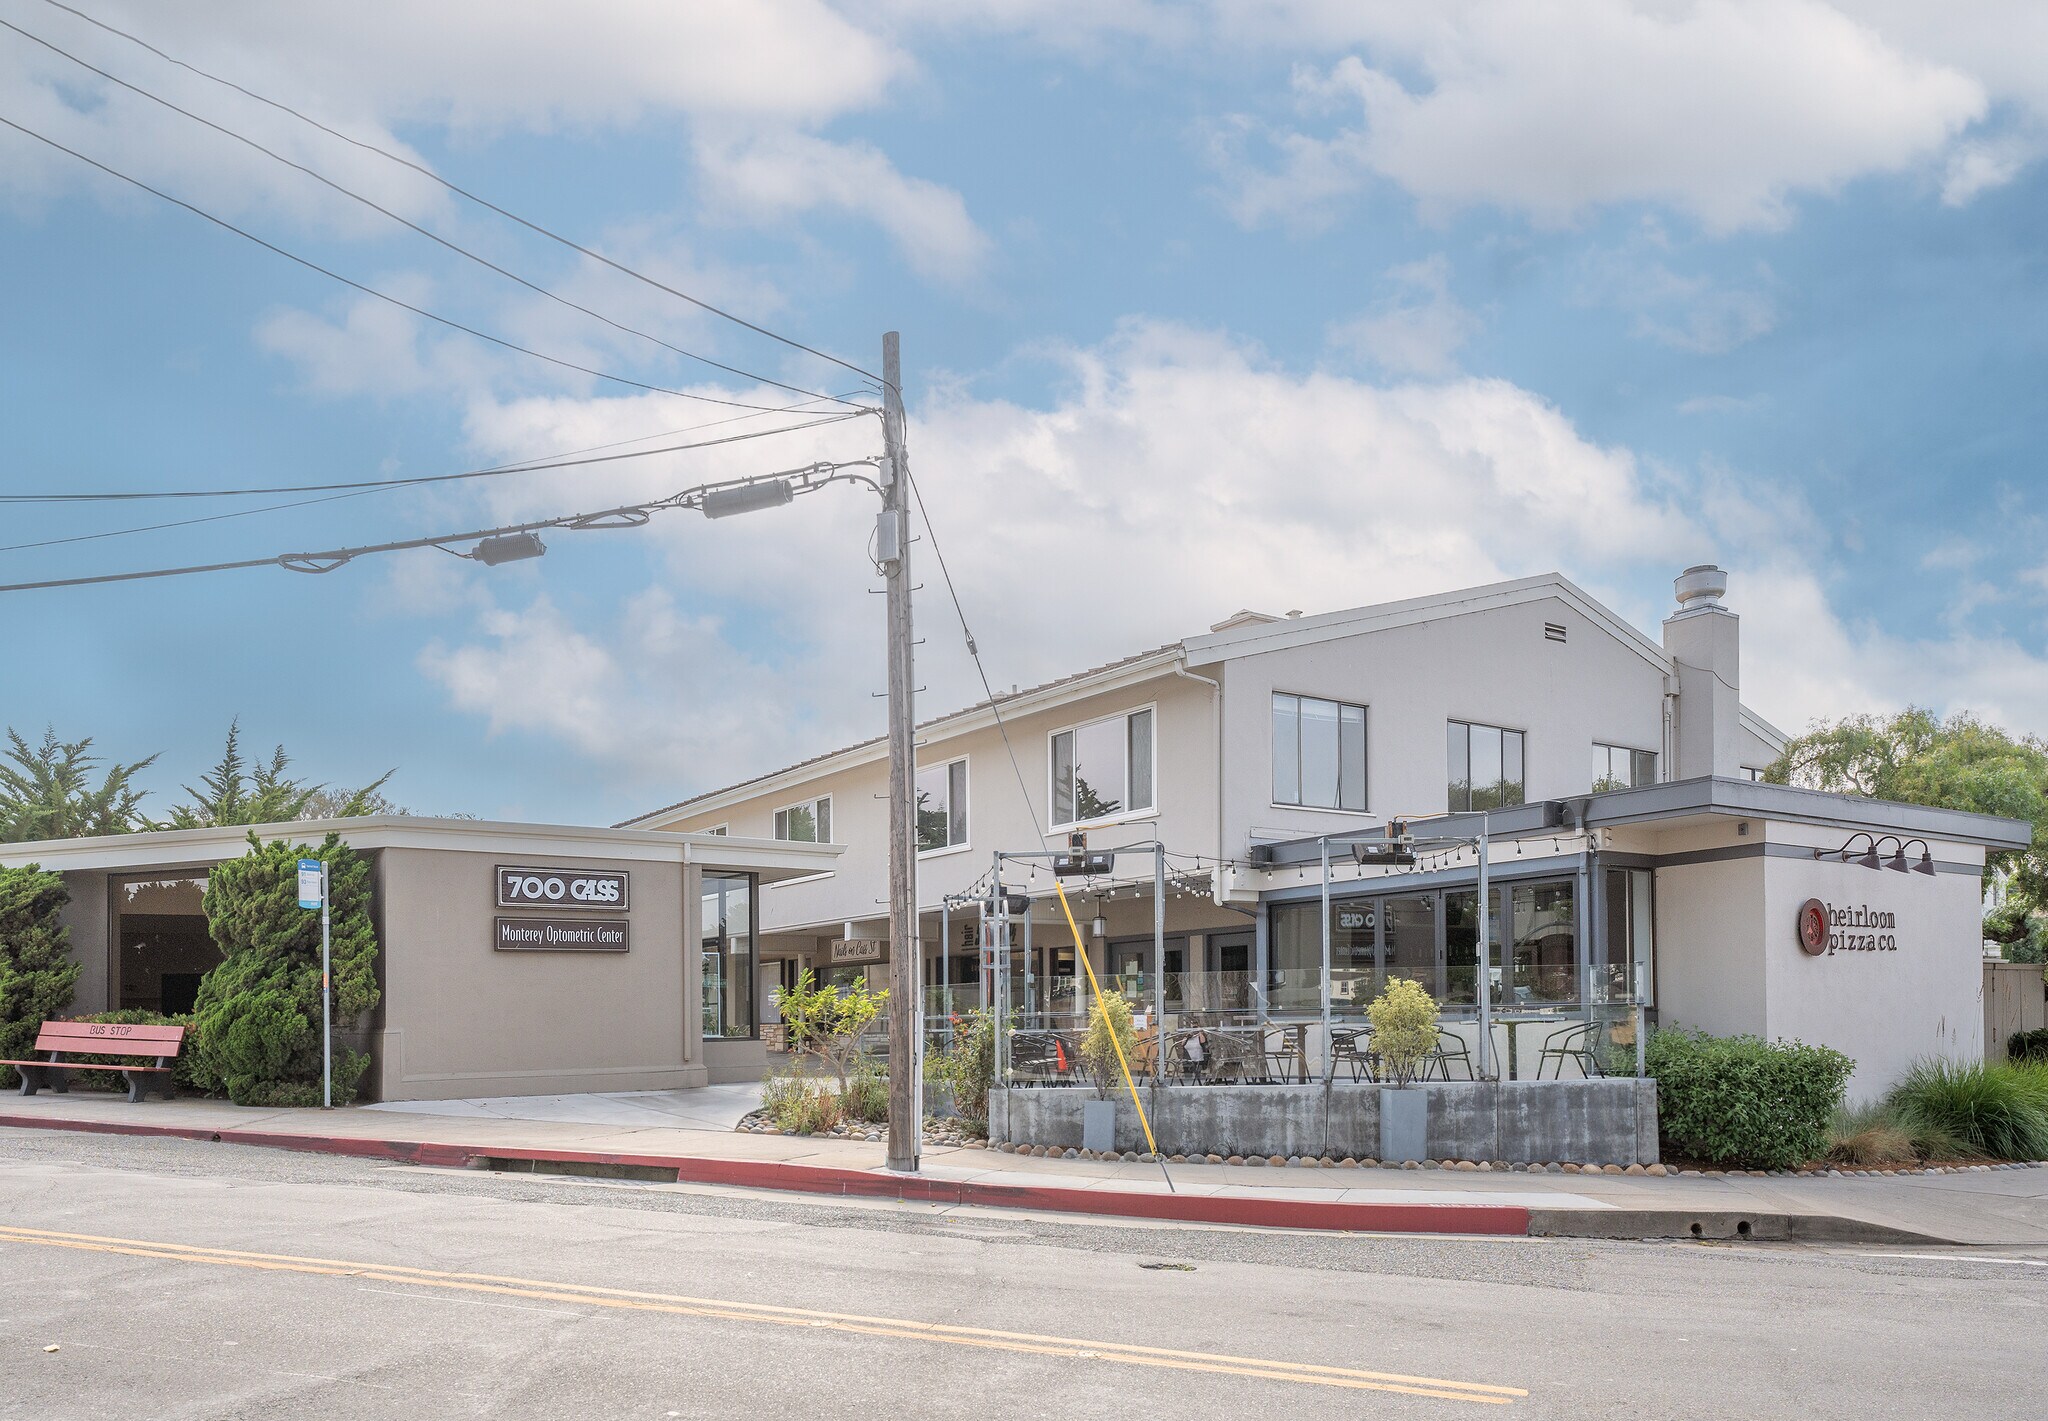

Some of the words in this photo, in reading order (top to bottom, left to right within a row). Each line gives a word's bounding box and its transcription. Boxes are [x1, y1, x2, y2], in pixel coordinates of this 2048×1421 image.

[507, 876, 566, 900] 700
[570, 879, 620, 902] CASS
[1827, 903, 1895, 929] heirloom
[502, 924, 544, 945] Monterey
[546, 925, 595, 945] Optometric
[597, 926, 624, 943] Center
[961, 924, 974, 947] hair
[1828, 930, 1876, 956] pizza
[90, 1025, 106, 1035] BUS
[110, 1026, 132, 1036] STOP
